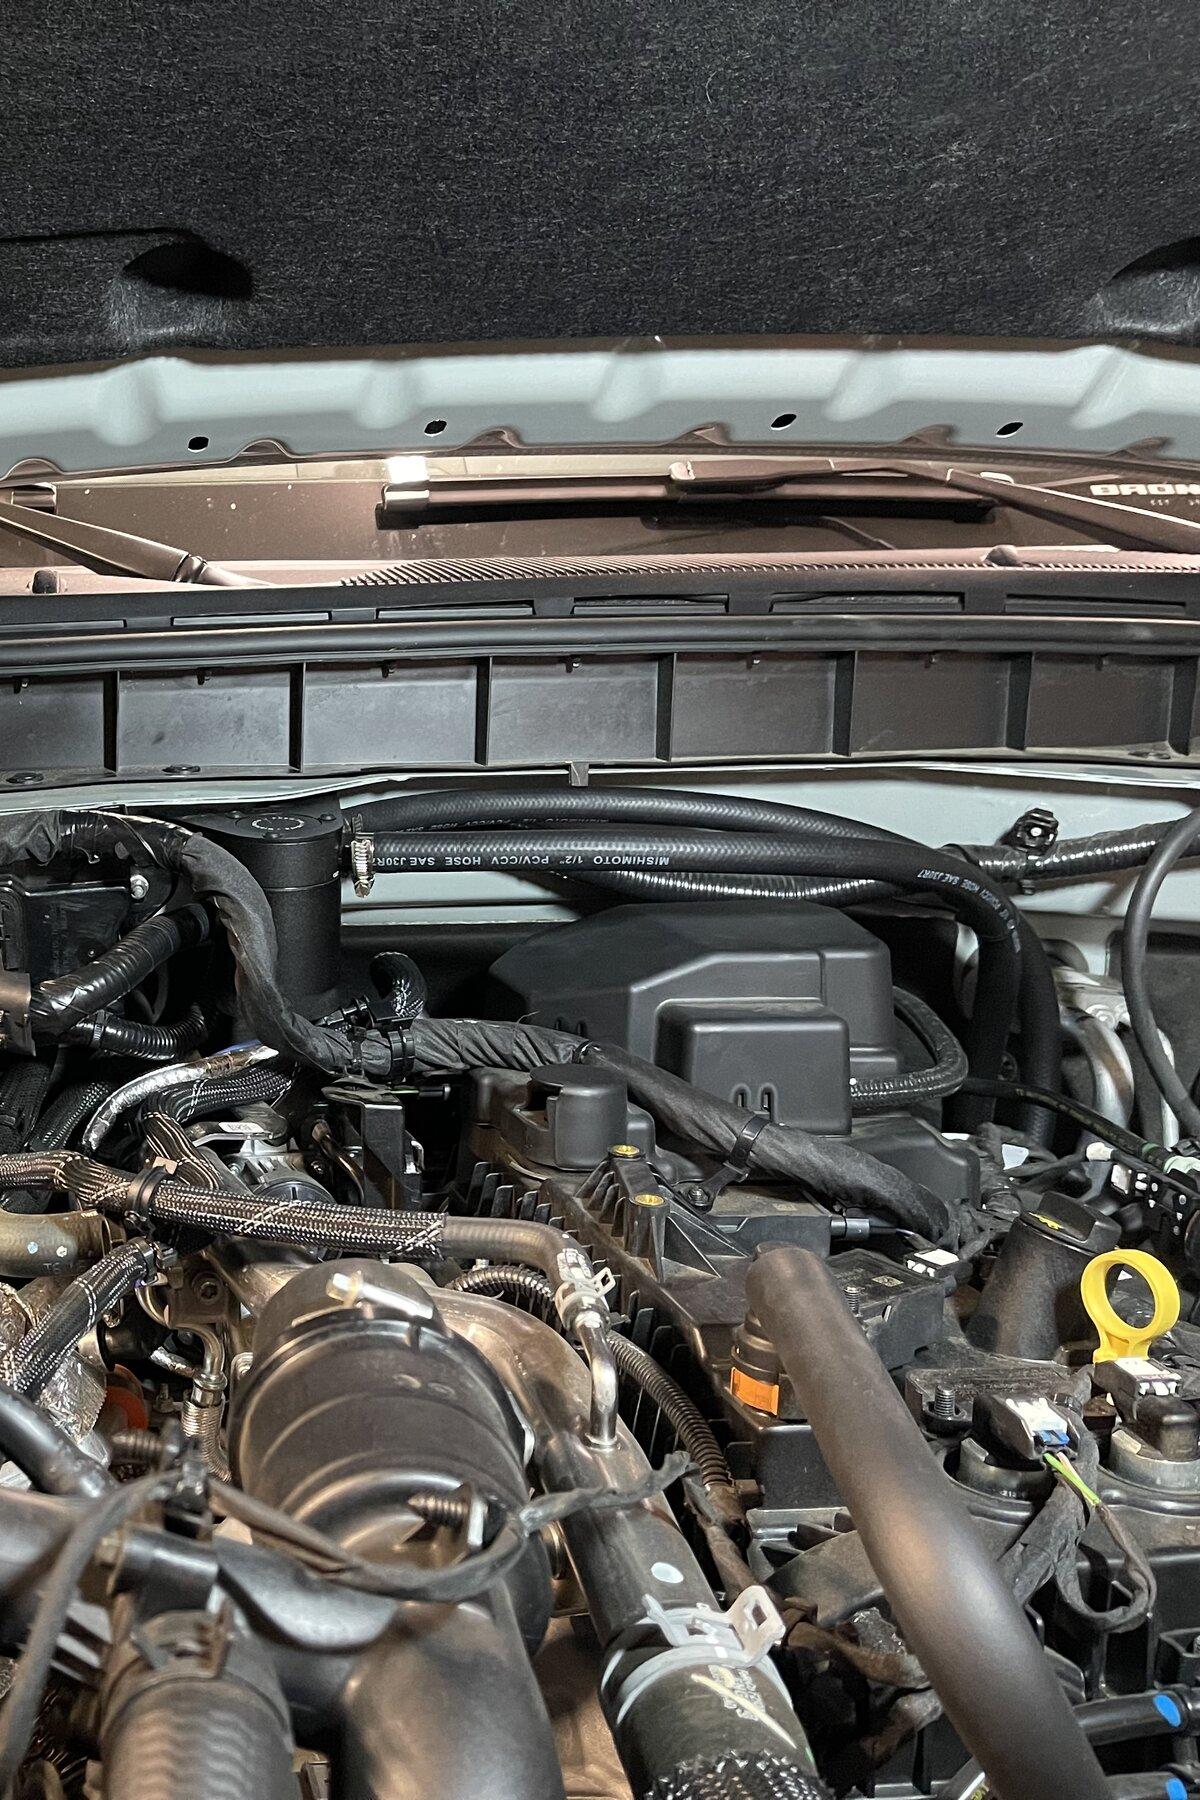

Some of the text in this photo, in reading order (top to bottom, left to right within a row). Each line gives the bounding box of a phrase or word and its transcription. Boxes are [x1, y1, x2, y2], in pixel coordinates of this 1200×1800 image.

[409, 856, 435, 866] SAE
[444, 856, 480, 865] HOSE
[491, 855, 549, 865] PCV/CCV
[560, 855, 583, 864] 1/2"
[593, 855, 670, 866] MISHIMOTO
